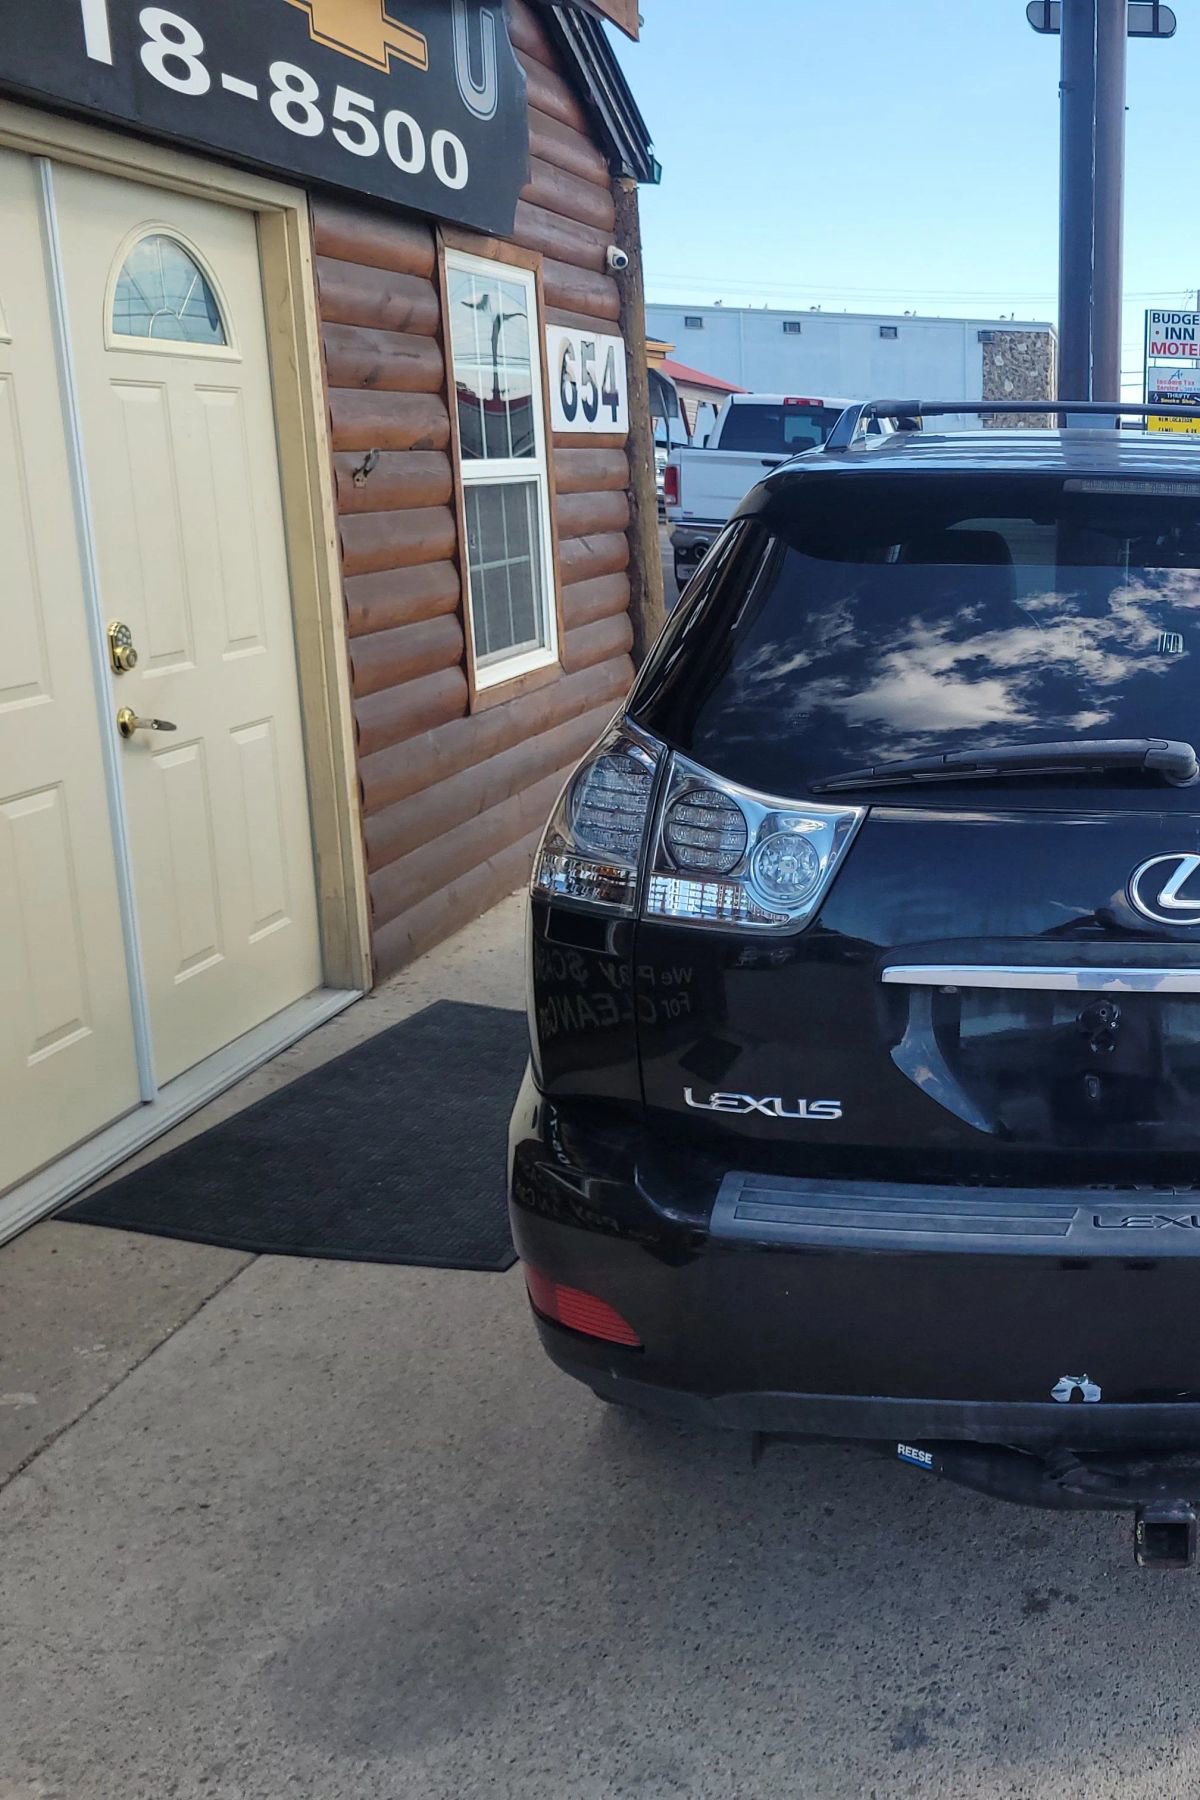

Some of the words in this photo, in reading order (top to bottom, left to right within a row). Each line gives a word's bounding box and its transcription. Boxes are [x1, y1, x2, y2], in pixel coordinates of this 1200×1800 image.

[1165, 327, 1195, 340] INN
[559, 336, 619, 422] 654
[682, 1087, 843, 1120] LEXUS
[897, 1444, 933, 1465] REESE
